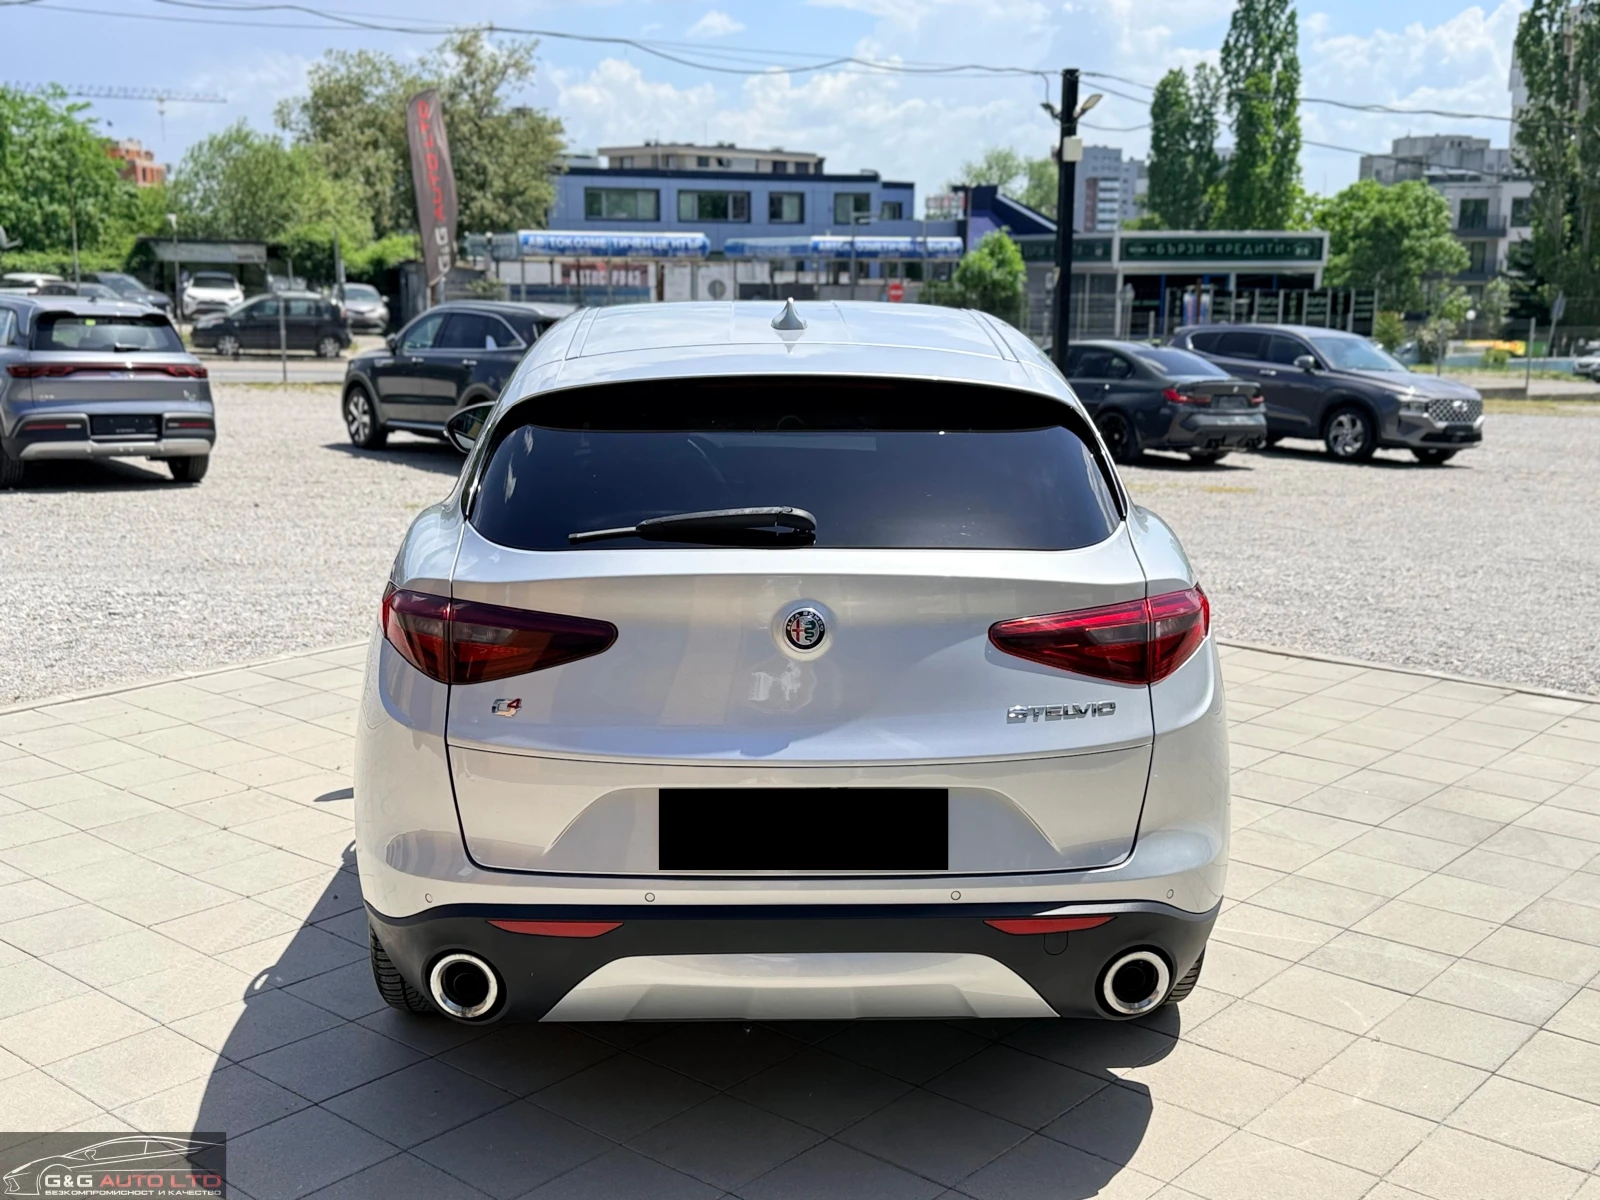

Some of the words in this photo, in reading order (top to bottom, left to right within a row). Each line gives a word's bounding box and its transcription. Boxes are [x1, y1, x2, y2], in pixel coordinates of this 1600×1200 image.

[417, 101, 434, 149] LTD
[425, 153, 446, 222] AUTO
[434, 226, 451, 273] G&G
[1156, 243, 1205, 255] БЪРЗИ
[1215, 242, 1285, 255] КРЕДИТИ
[1006, 700, 1117, 724] STELVIO
